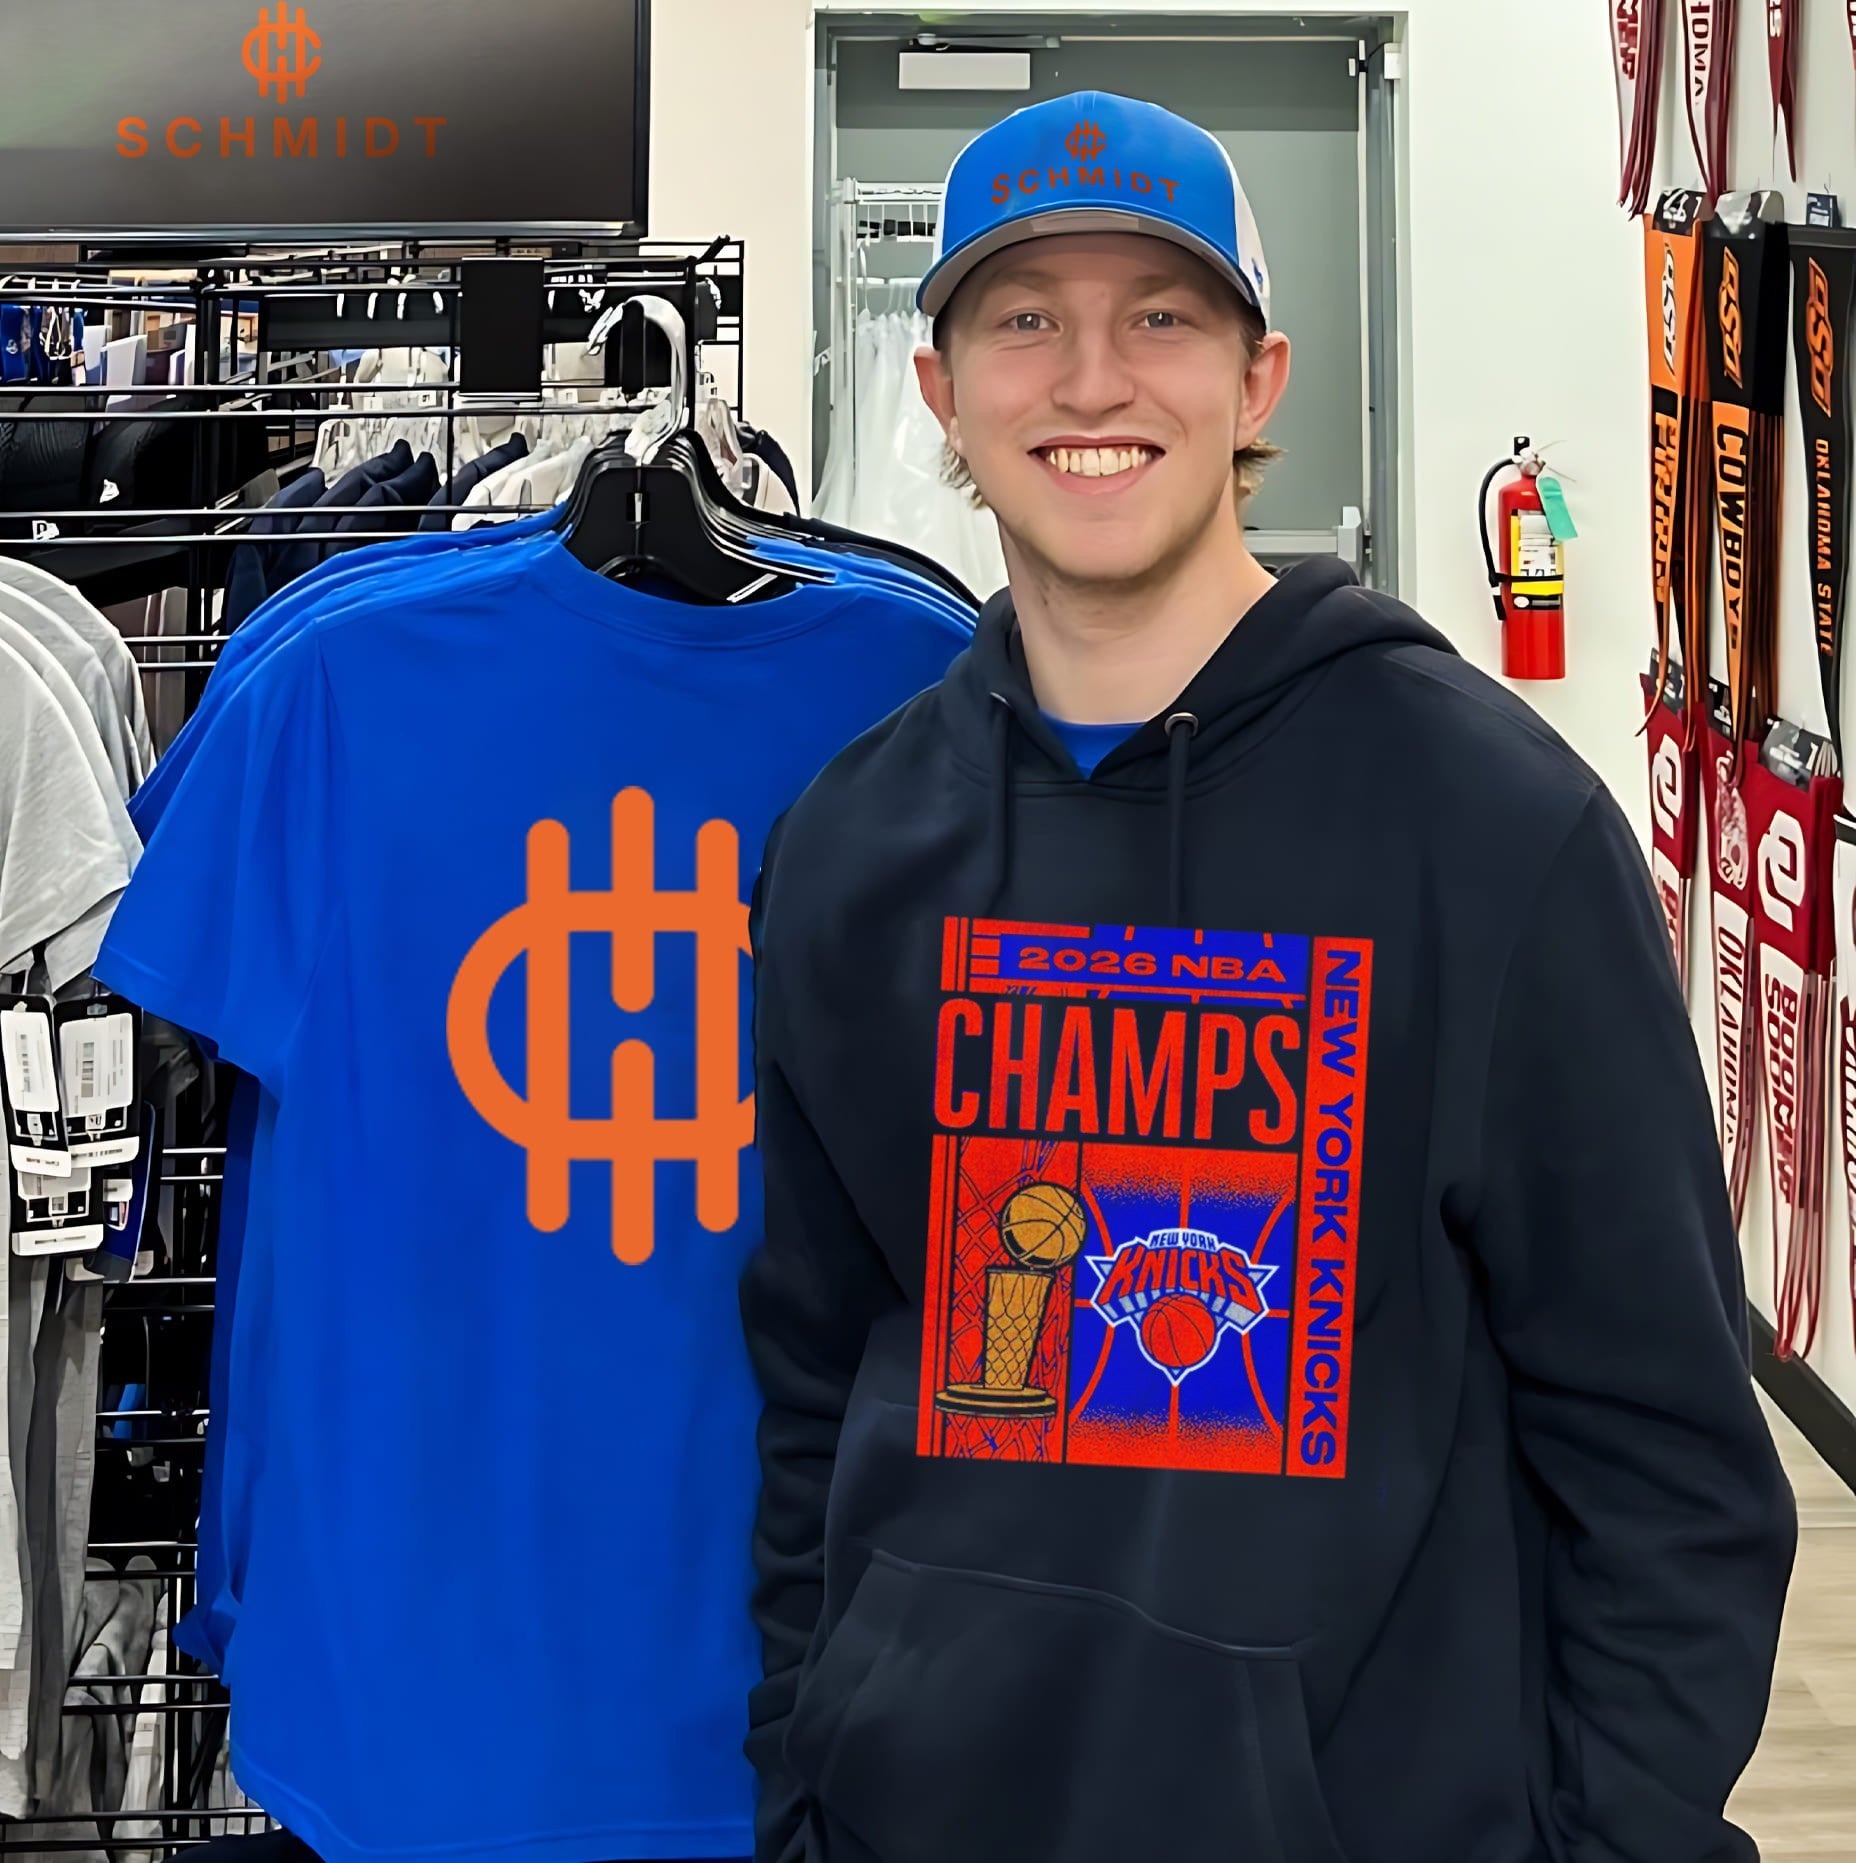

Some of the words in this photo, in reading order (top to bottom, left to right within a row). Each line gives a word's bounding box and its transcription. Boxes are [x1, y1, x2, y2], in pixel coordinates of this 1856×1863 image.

[115, 116, 448, 159] SCHMIDT
[991, 166, 1180, 205] SCHMIDT
[1815, 438, 1832, 571] OKLAHOMA
[1017, 946, 1158, 976] 2026
[1172, 953, 1287, 983] NBA
[1322, 949, 1362, 1078] NEW
[933, 997, 1301, 1146] CHAMPS
[1313, 1091, 1355, 1245] YORK
[1097, 1245, 1263, 1315] KNICKS
[1149, 1231, 1179, 1248] NEW
[1181, 1231, 1217, 1251] YORK
[1301, 1259, 1347, 1467] KNICKS
